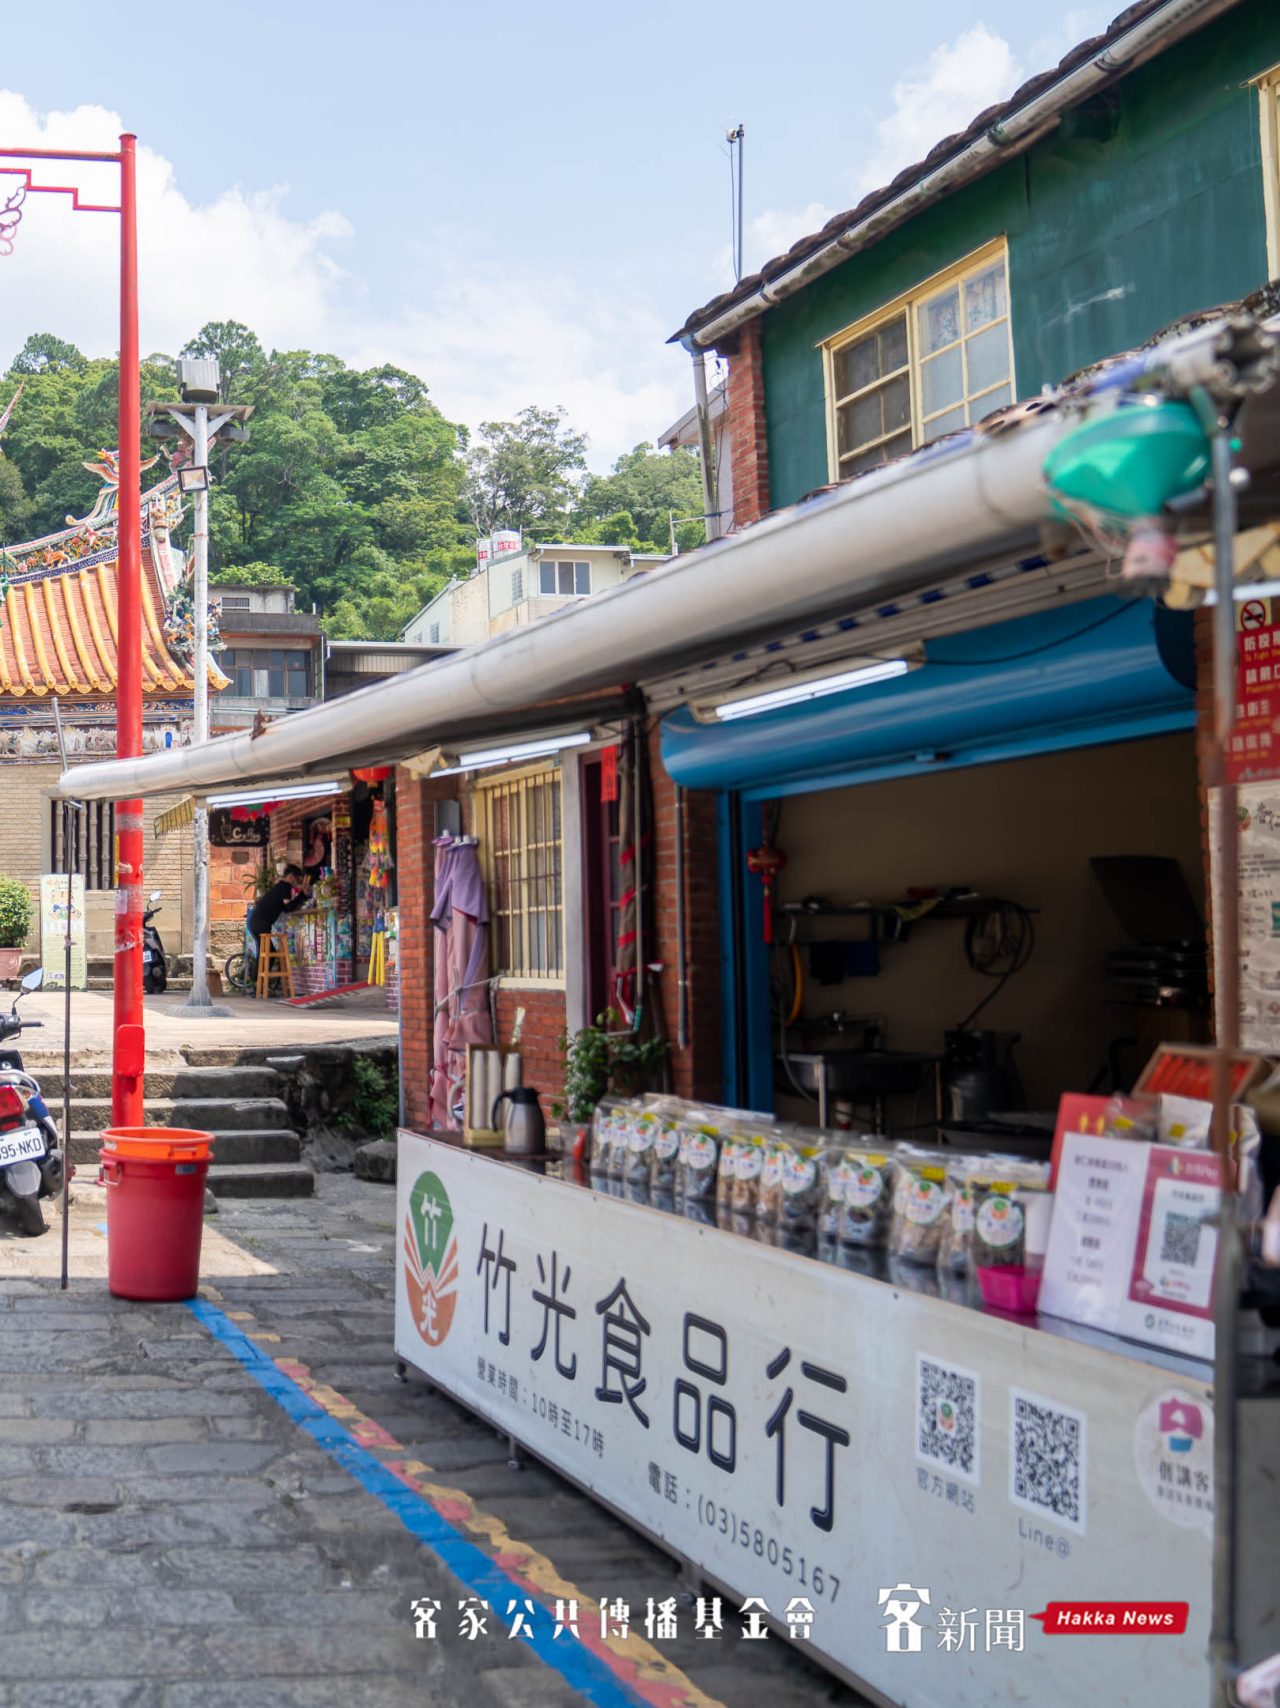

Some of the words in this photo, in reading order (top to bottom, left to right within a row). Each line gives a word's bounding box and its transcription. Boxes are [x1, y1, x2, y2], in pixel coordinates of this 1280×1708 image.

[477, 1222, 850, 1532] 竹光食品行
[916, 1467, 975, 1513] 官方網站
[1018, 1517, 1070, 1558] Line@
